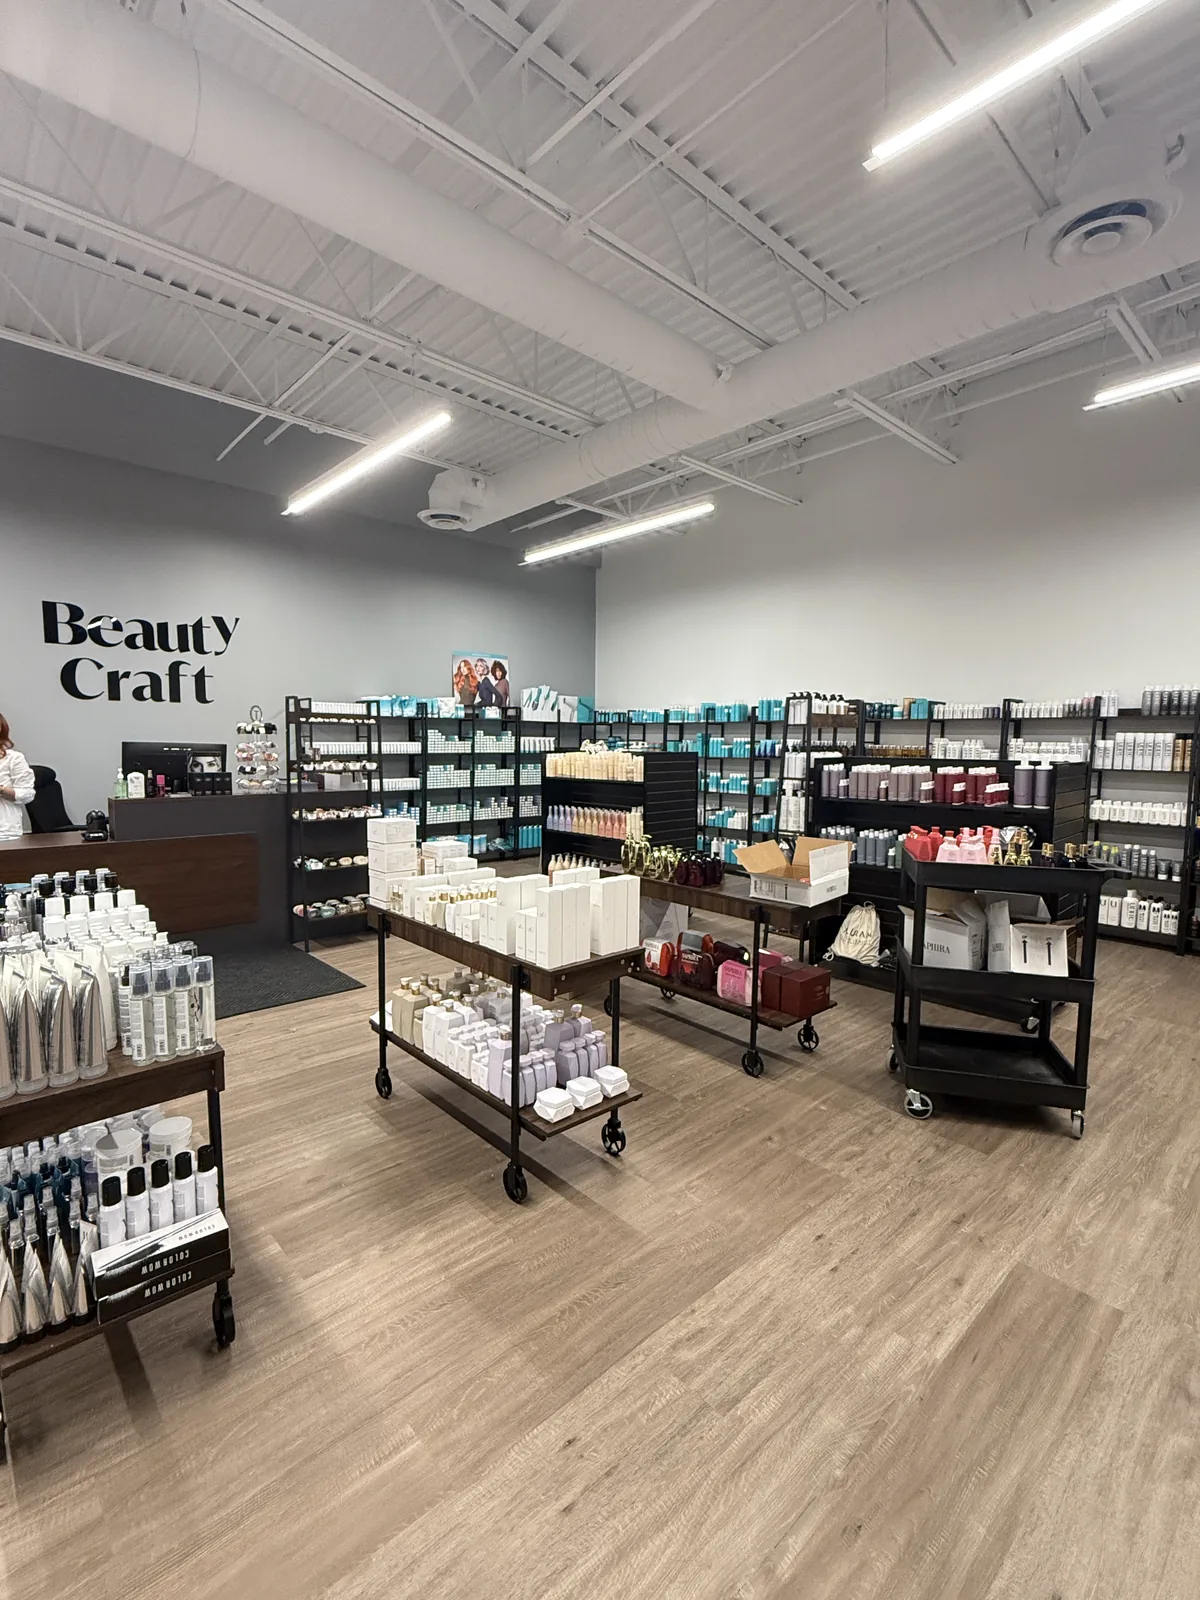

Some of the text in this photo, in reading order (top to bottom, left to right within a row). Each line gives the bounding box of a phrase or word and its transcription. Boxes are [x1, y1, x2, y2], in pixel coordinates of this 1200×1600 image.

[42, 600, 240, 656] Beauty
[60, 657, 214, 704] Craft
[923, 942, 951, 954] PHIRA
[141, 1249, 189, 1275] COLOR WOW
[144, 1271, 191, 1297] COLOR WOW
